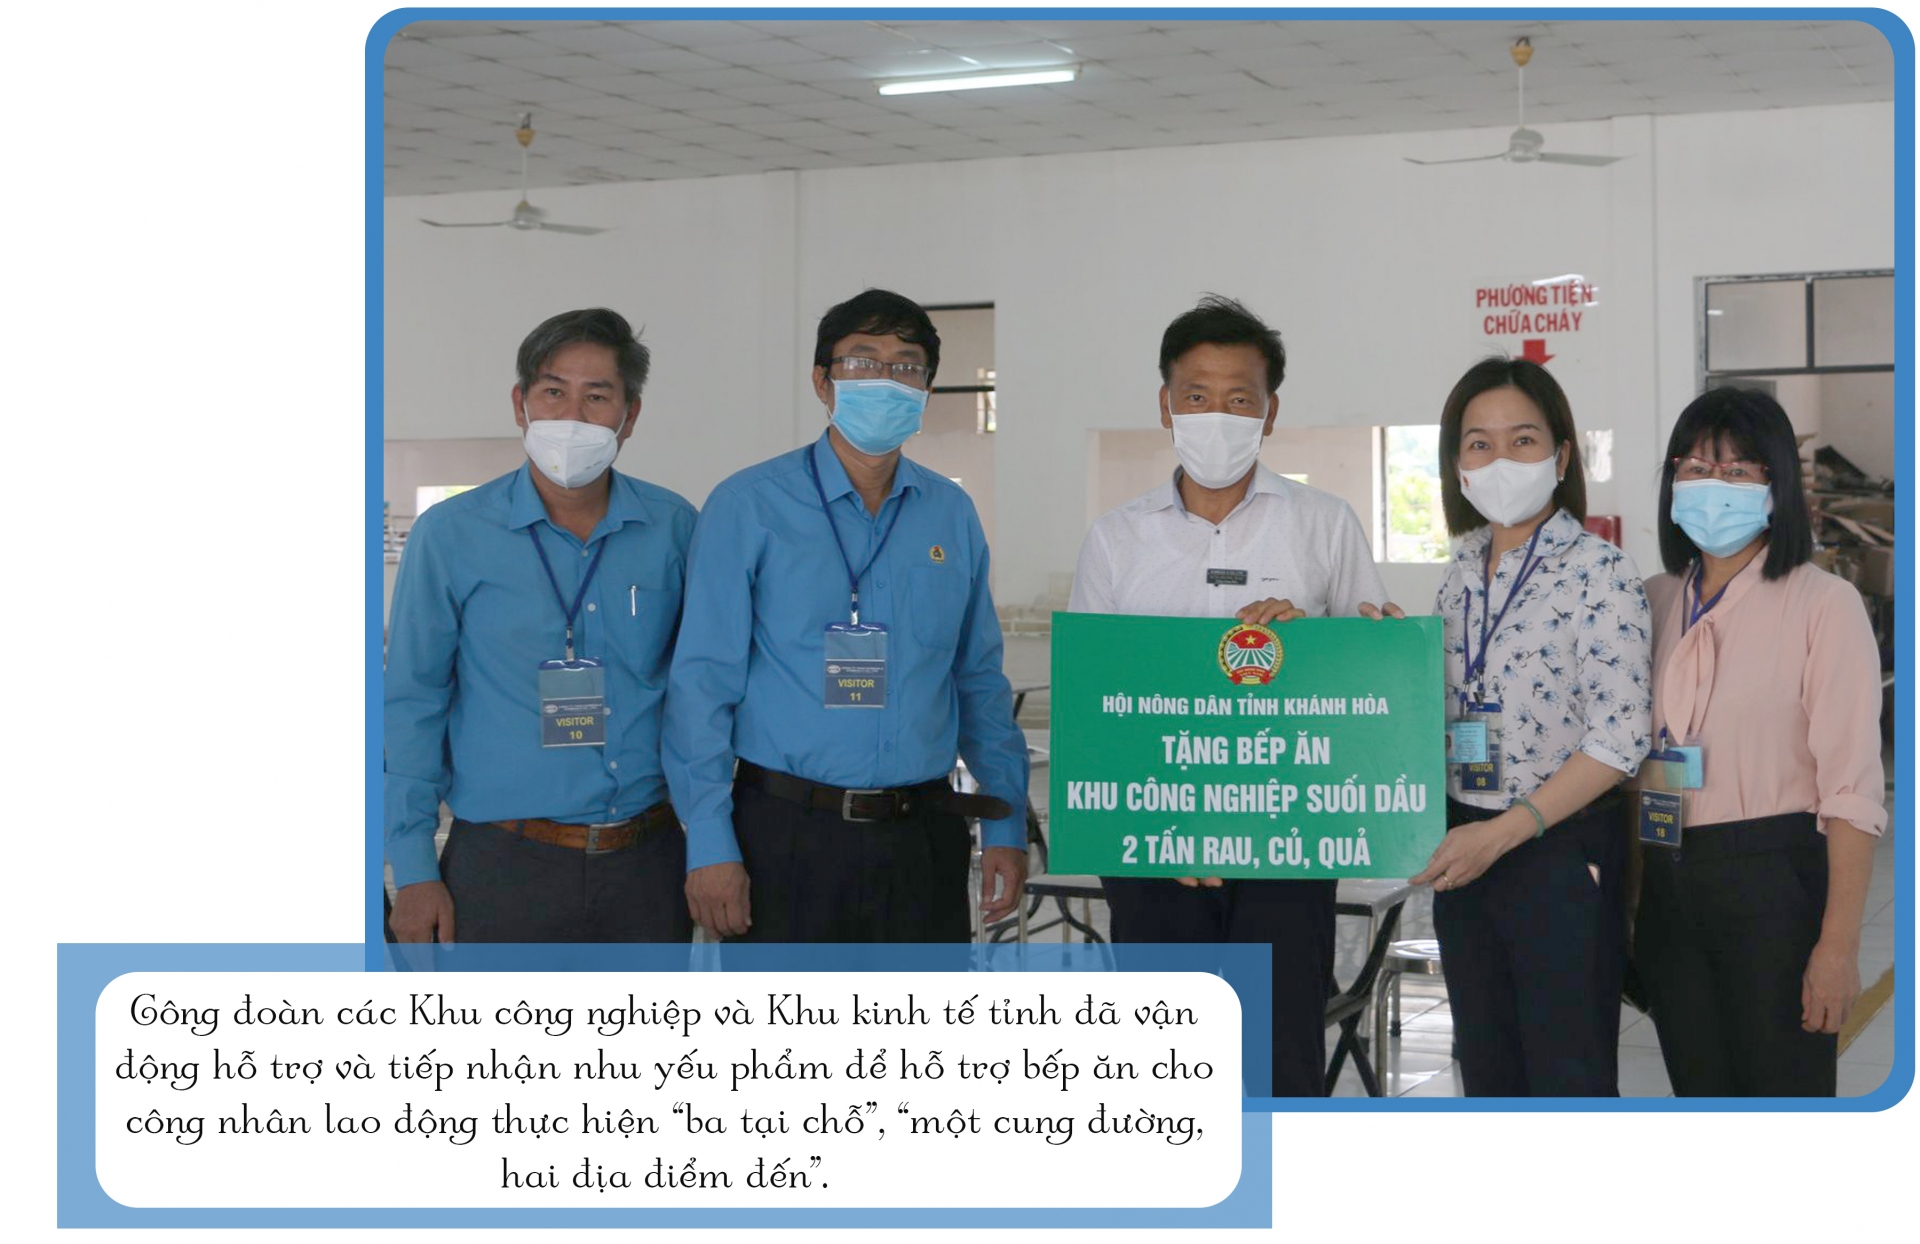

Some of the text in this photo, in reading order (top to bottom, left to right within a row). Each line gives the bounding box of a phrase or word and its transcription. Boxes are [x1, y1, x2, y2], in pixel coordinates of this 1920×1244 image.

[1476, 284, 1548, 308] PHƯƠNG
[1483, 307, 1583, 335] CHỮA CHÁY
[838, 678, 875, 688] VISITOR
[849, 692, 862, 702] 11
[1102, 693, 1389, 717] HỘI NÔNG DÂN TỈNH KHÁNH HÒA
[556, 716, 595, 727] VISITOR
[570, 731, 583, 740] 10
[1162, 727, 1331, 770] TẶNG BẾP ĂN
[1469, 763, 1495, 773] VISITOR
[1067, 773, 1427, 819] KHU CÔNG NGHIỆP SUỐI DẦU
[1648, 811, 1675, 824] VISITOR
[1122, 826, 1371, 869] 2 TẤN RAU, CỦ, QUẢ
